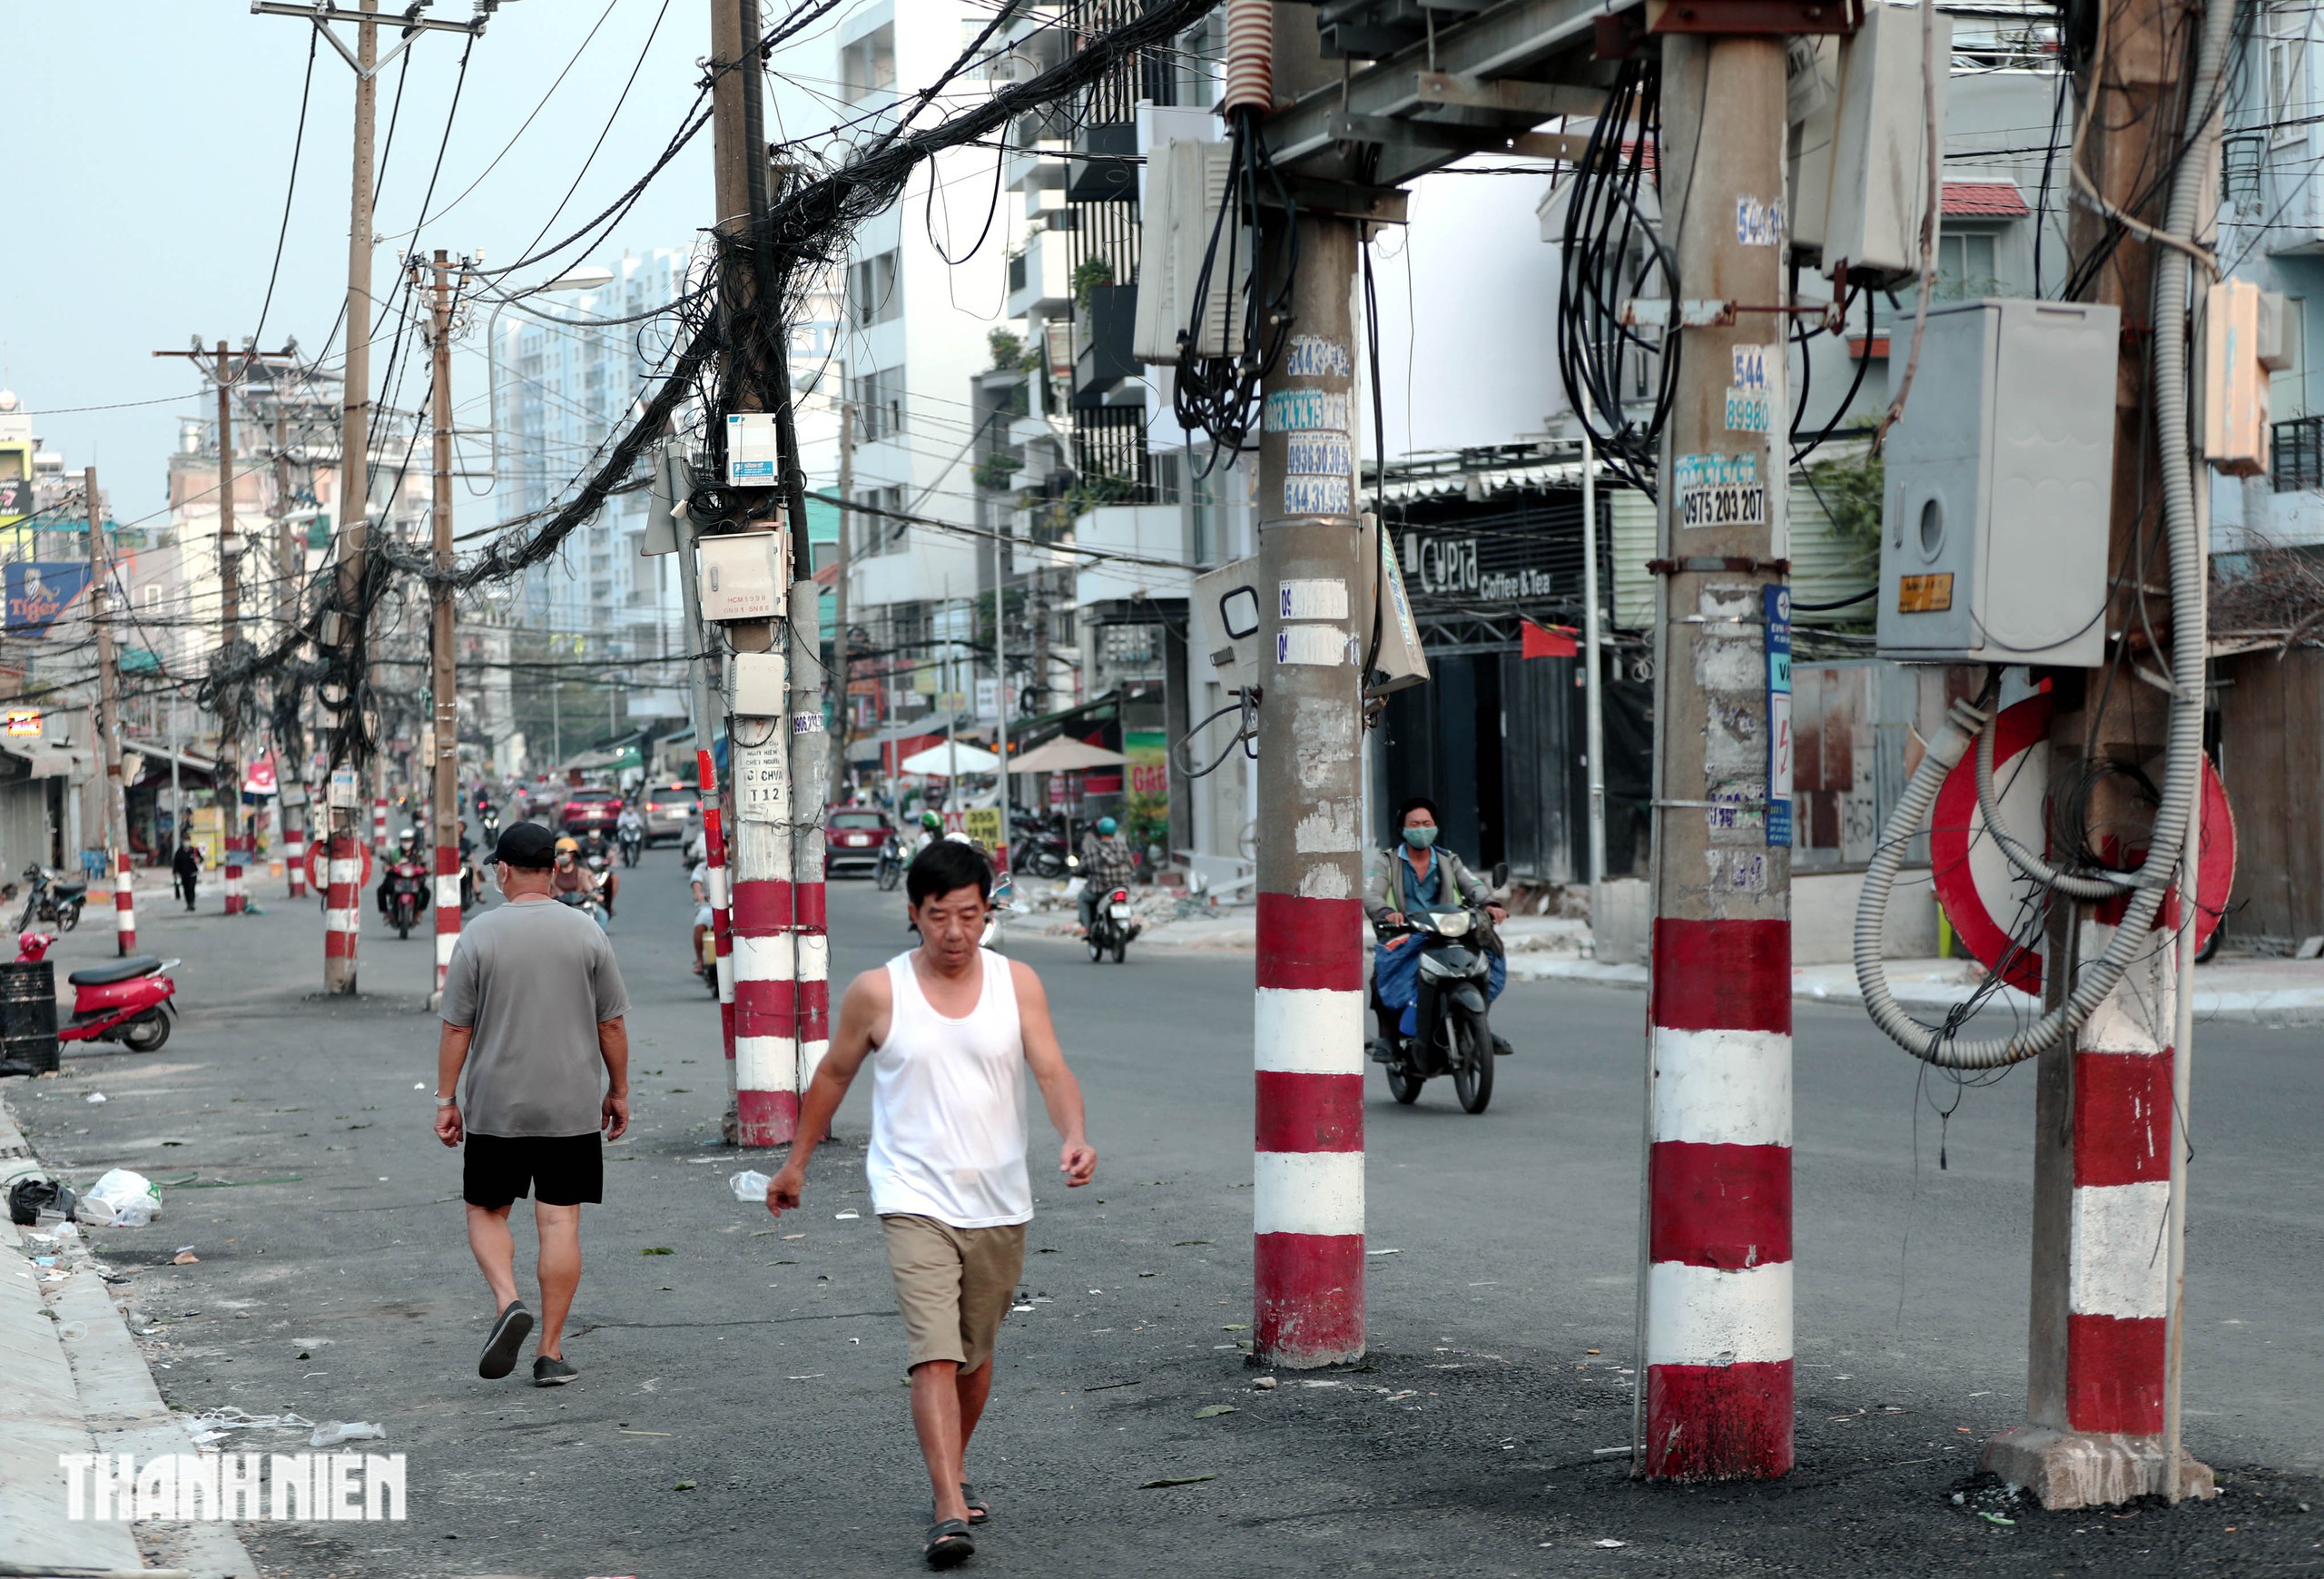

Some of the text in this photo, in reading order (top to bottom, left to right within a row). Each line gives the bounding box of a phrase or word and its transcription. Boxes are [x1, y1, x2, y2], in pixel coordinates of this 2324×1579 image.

[1727, 399, 1769, 431] 89980
[1684, 489, 1764, 525] 0975.203.207
[1479, 568, 1551, 600] Coffee & Tea
[9, 597, 61, 624] Tiger
